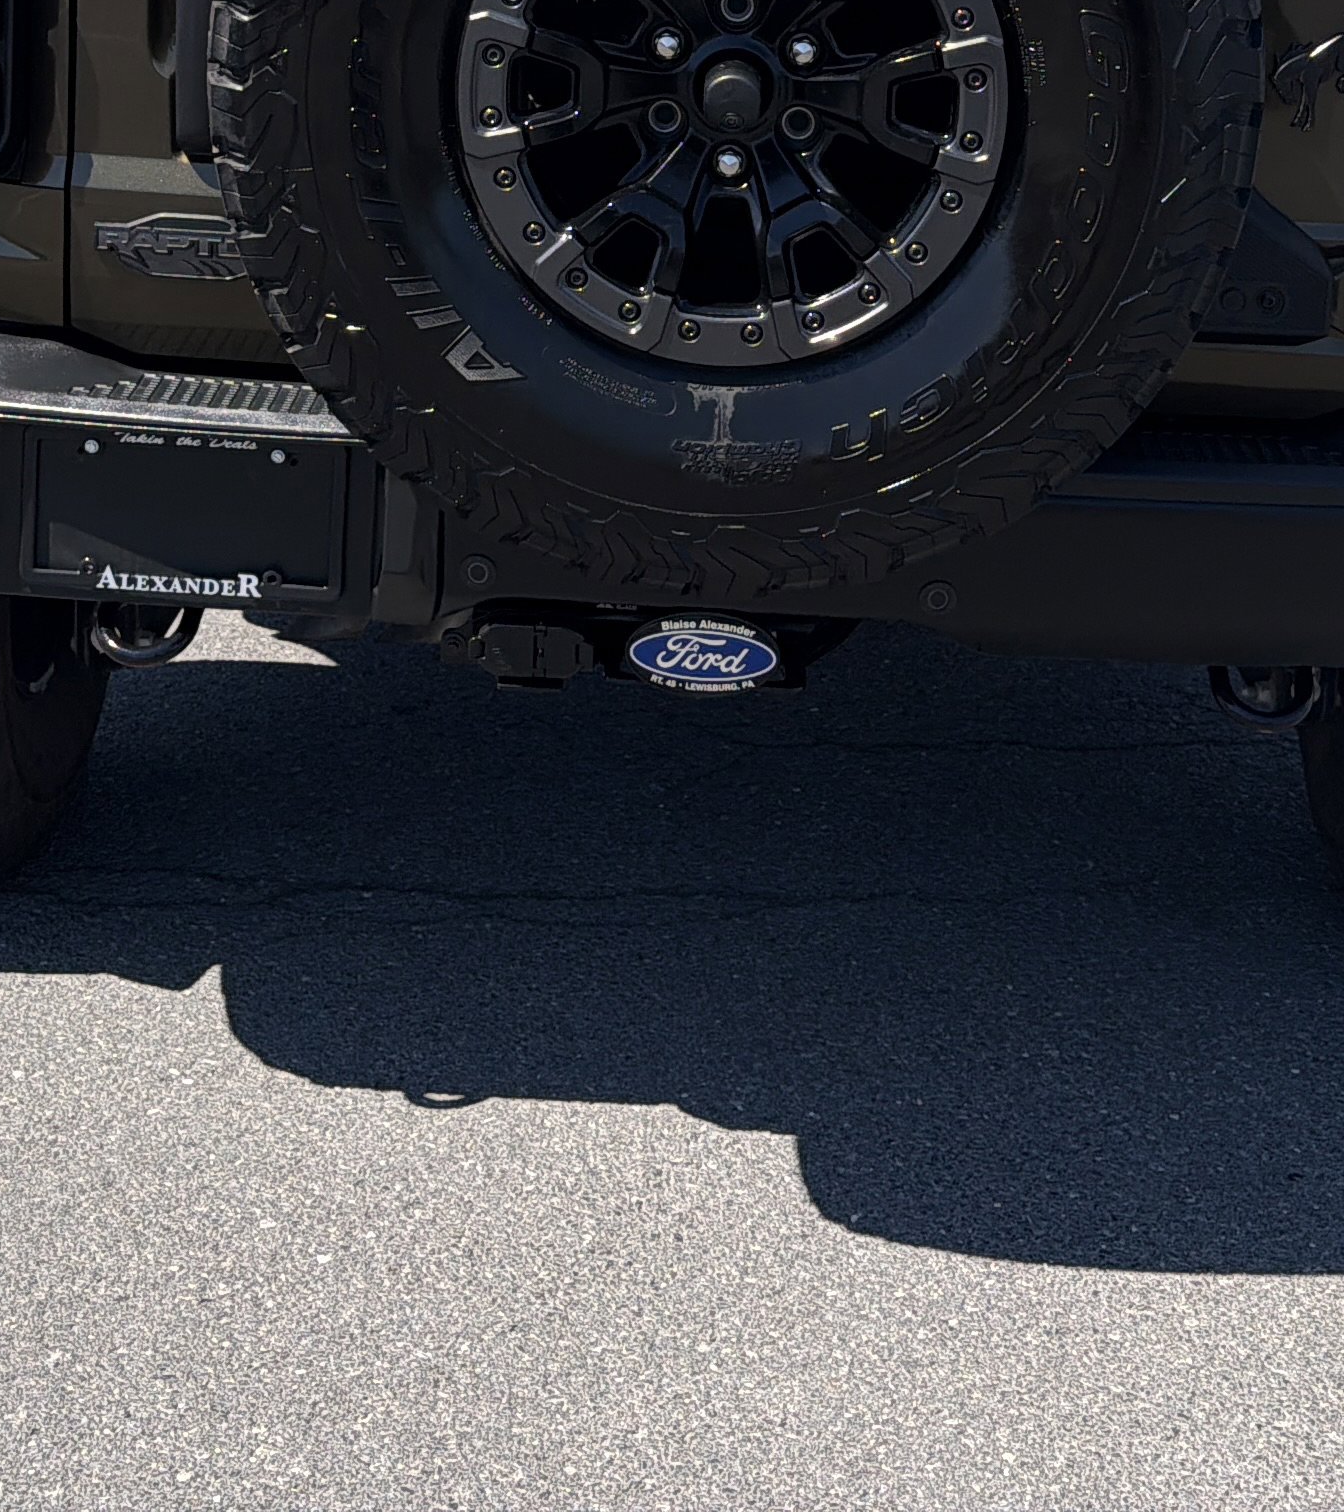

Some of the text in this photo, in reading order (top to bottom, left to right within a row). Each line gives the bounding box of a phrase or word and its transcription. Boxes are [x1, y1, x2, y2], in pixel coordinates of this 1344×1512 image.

[175, 435, 202, 447] the
[660, 619, 757, 638] Blaise Alexander
[656, 634, 751, 674] Ford
[741, 679, 757, 690] PA
